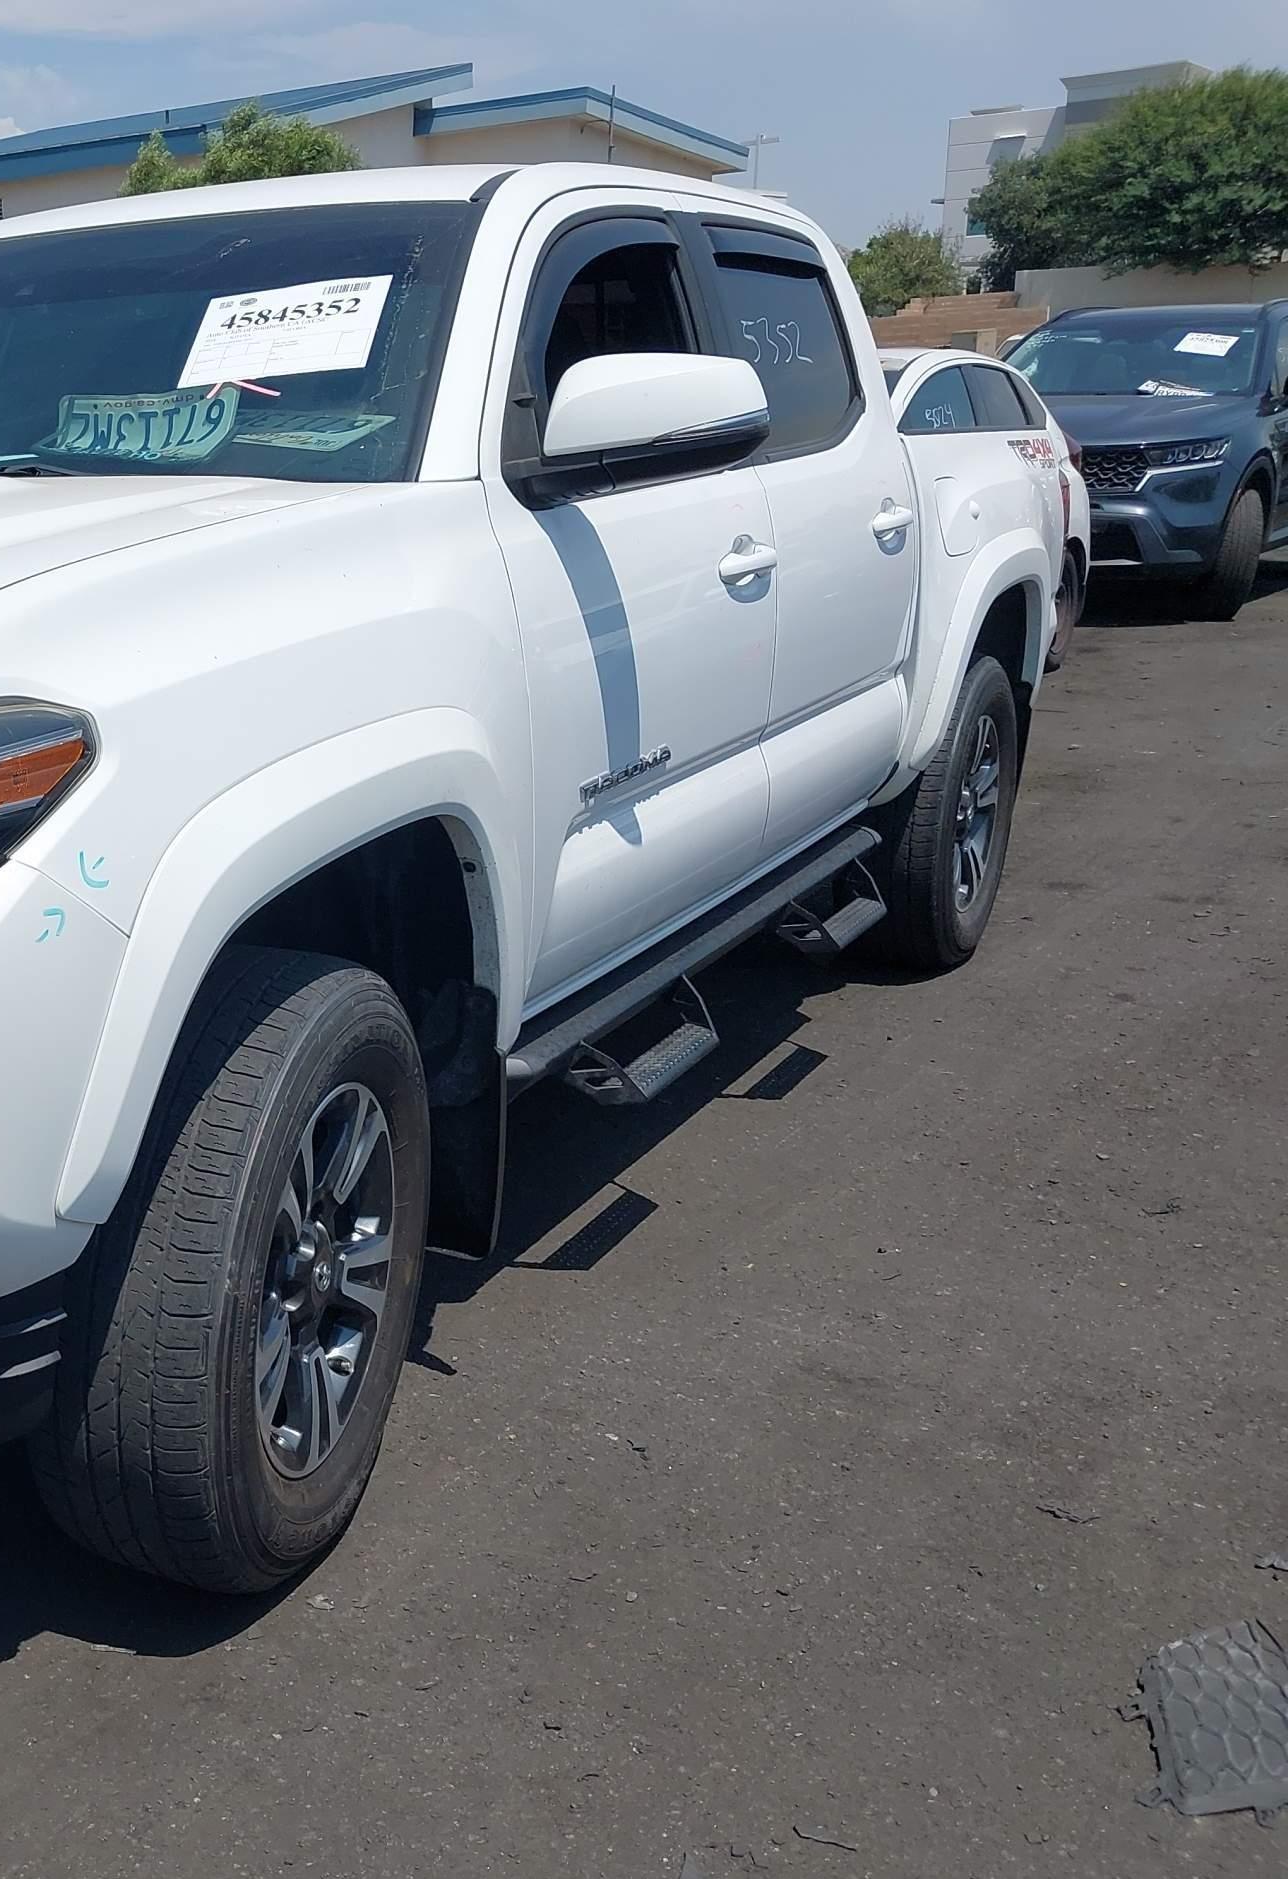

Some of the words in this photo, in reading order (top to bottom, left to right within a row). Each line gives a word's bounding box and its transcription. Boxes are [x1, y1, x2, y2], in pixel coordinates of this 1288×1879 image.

[220, 297, 361, 330] 45845352
[740, 317, 814, 364] 5352
[103, 394, 194, 408] dmv.ca.gov
